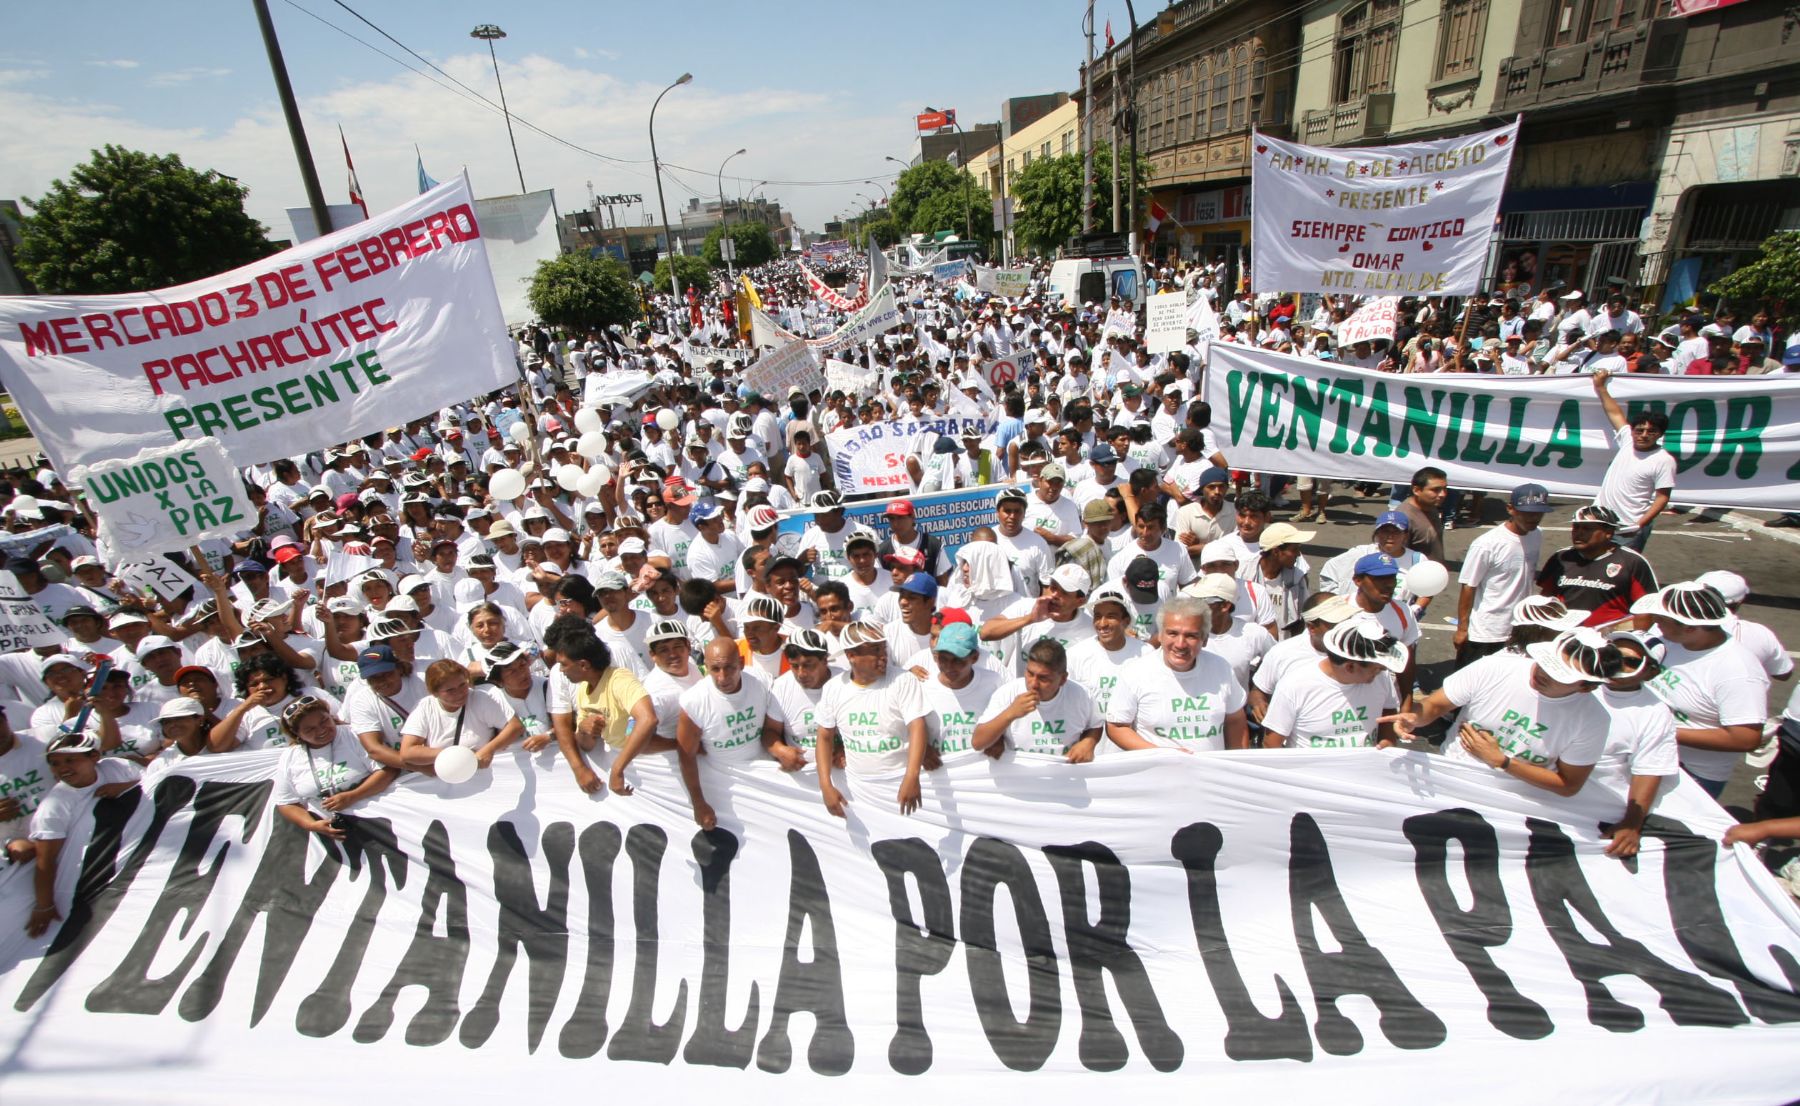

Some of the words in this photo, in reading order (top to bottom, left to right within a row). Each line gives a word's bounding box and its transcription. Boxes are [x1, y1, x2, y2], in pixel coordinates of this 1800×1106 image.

[1371, 159, 1394, 177] DE
[1408, 144, 1486, 175] AGOSTO
[596, 194, 642, 208] Norky's
[1338, 186, 1430, 210] PRESENTE
[1291, 220, 1367, 242] SIEMPRE
[1387, 218, 1465, 242] CONTIGO
[1352, 253, 1404, 270] OMAR
[19, 295, 231, 357] MERCADO
[226, 283, 259, 320] 3
[254, 265, 316, 310] DE
[312, 202, 481, 292] FEBRERO
[1363, 271, 1450, 291] ALCALDE
[142, 297, 397, 396] PACHACÚTEC
[164, 350, 391, 441] PRESENTE
[1226, 370, 1584, 469] VENTANILLA
[87, 451, 206, 504] UNIDOS
[185, 478, 218, 500] LA
[169, 496, 244, 536] PAZ
[1036, 518, 1057, 529] PAZ
[921, 518, 967, 534] TRABAJOS
[949, 534, 962, 546] DE
[822, 549, 845, 559] PAZ
[1558, 575, 1616, 591] Budweiser
[1171, 695, 1211, 713] PAZ
[725, 705, 757, 729] PAZ
[849, 711, 879, 727] PAZ
[942, 711, 976, 726] PAZ
[1176, 715, 1190, 724] EN
[1192, 715, 1208, 723] EL
[1331, 706, 1369, 725] PAZ
[1502, 709, 1549, 739] PAZ
[731, 727, 744, 737] EN
[746, 721, 757, 731] EL
[852, 729, 865, 737] EN
[867, 729, 879, 737] EL
[947, 729, 960, 737] EN
[961, 729, 974, 737] EL
[1031, 719, 1066, 735] PAZ
[1335, 727, 1349, 736] EN
[1351, 724, 1365, 733] EL
[1498, 725, 1516, 736] EN
[1517, 733, 1531, 746] EL
[1035, 738, 1048, 746] EN
[1050, 737, 1063, 746] EL
[0, 769, 43, 797] PAZ
[18, 775, 855, 1077] VENTANILLA
[871, 834, 1184, 1077] POR
[1170, 811, 1447, 1063] LA
[1402, 807, 1800, 1042] PAZ
